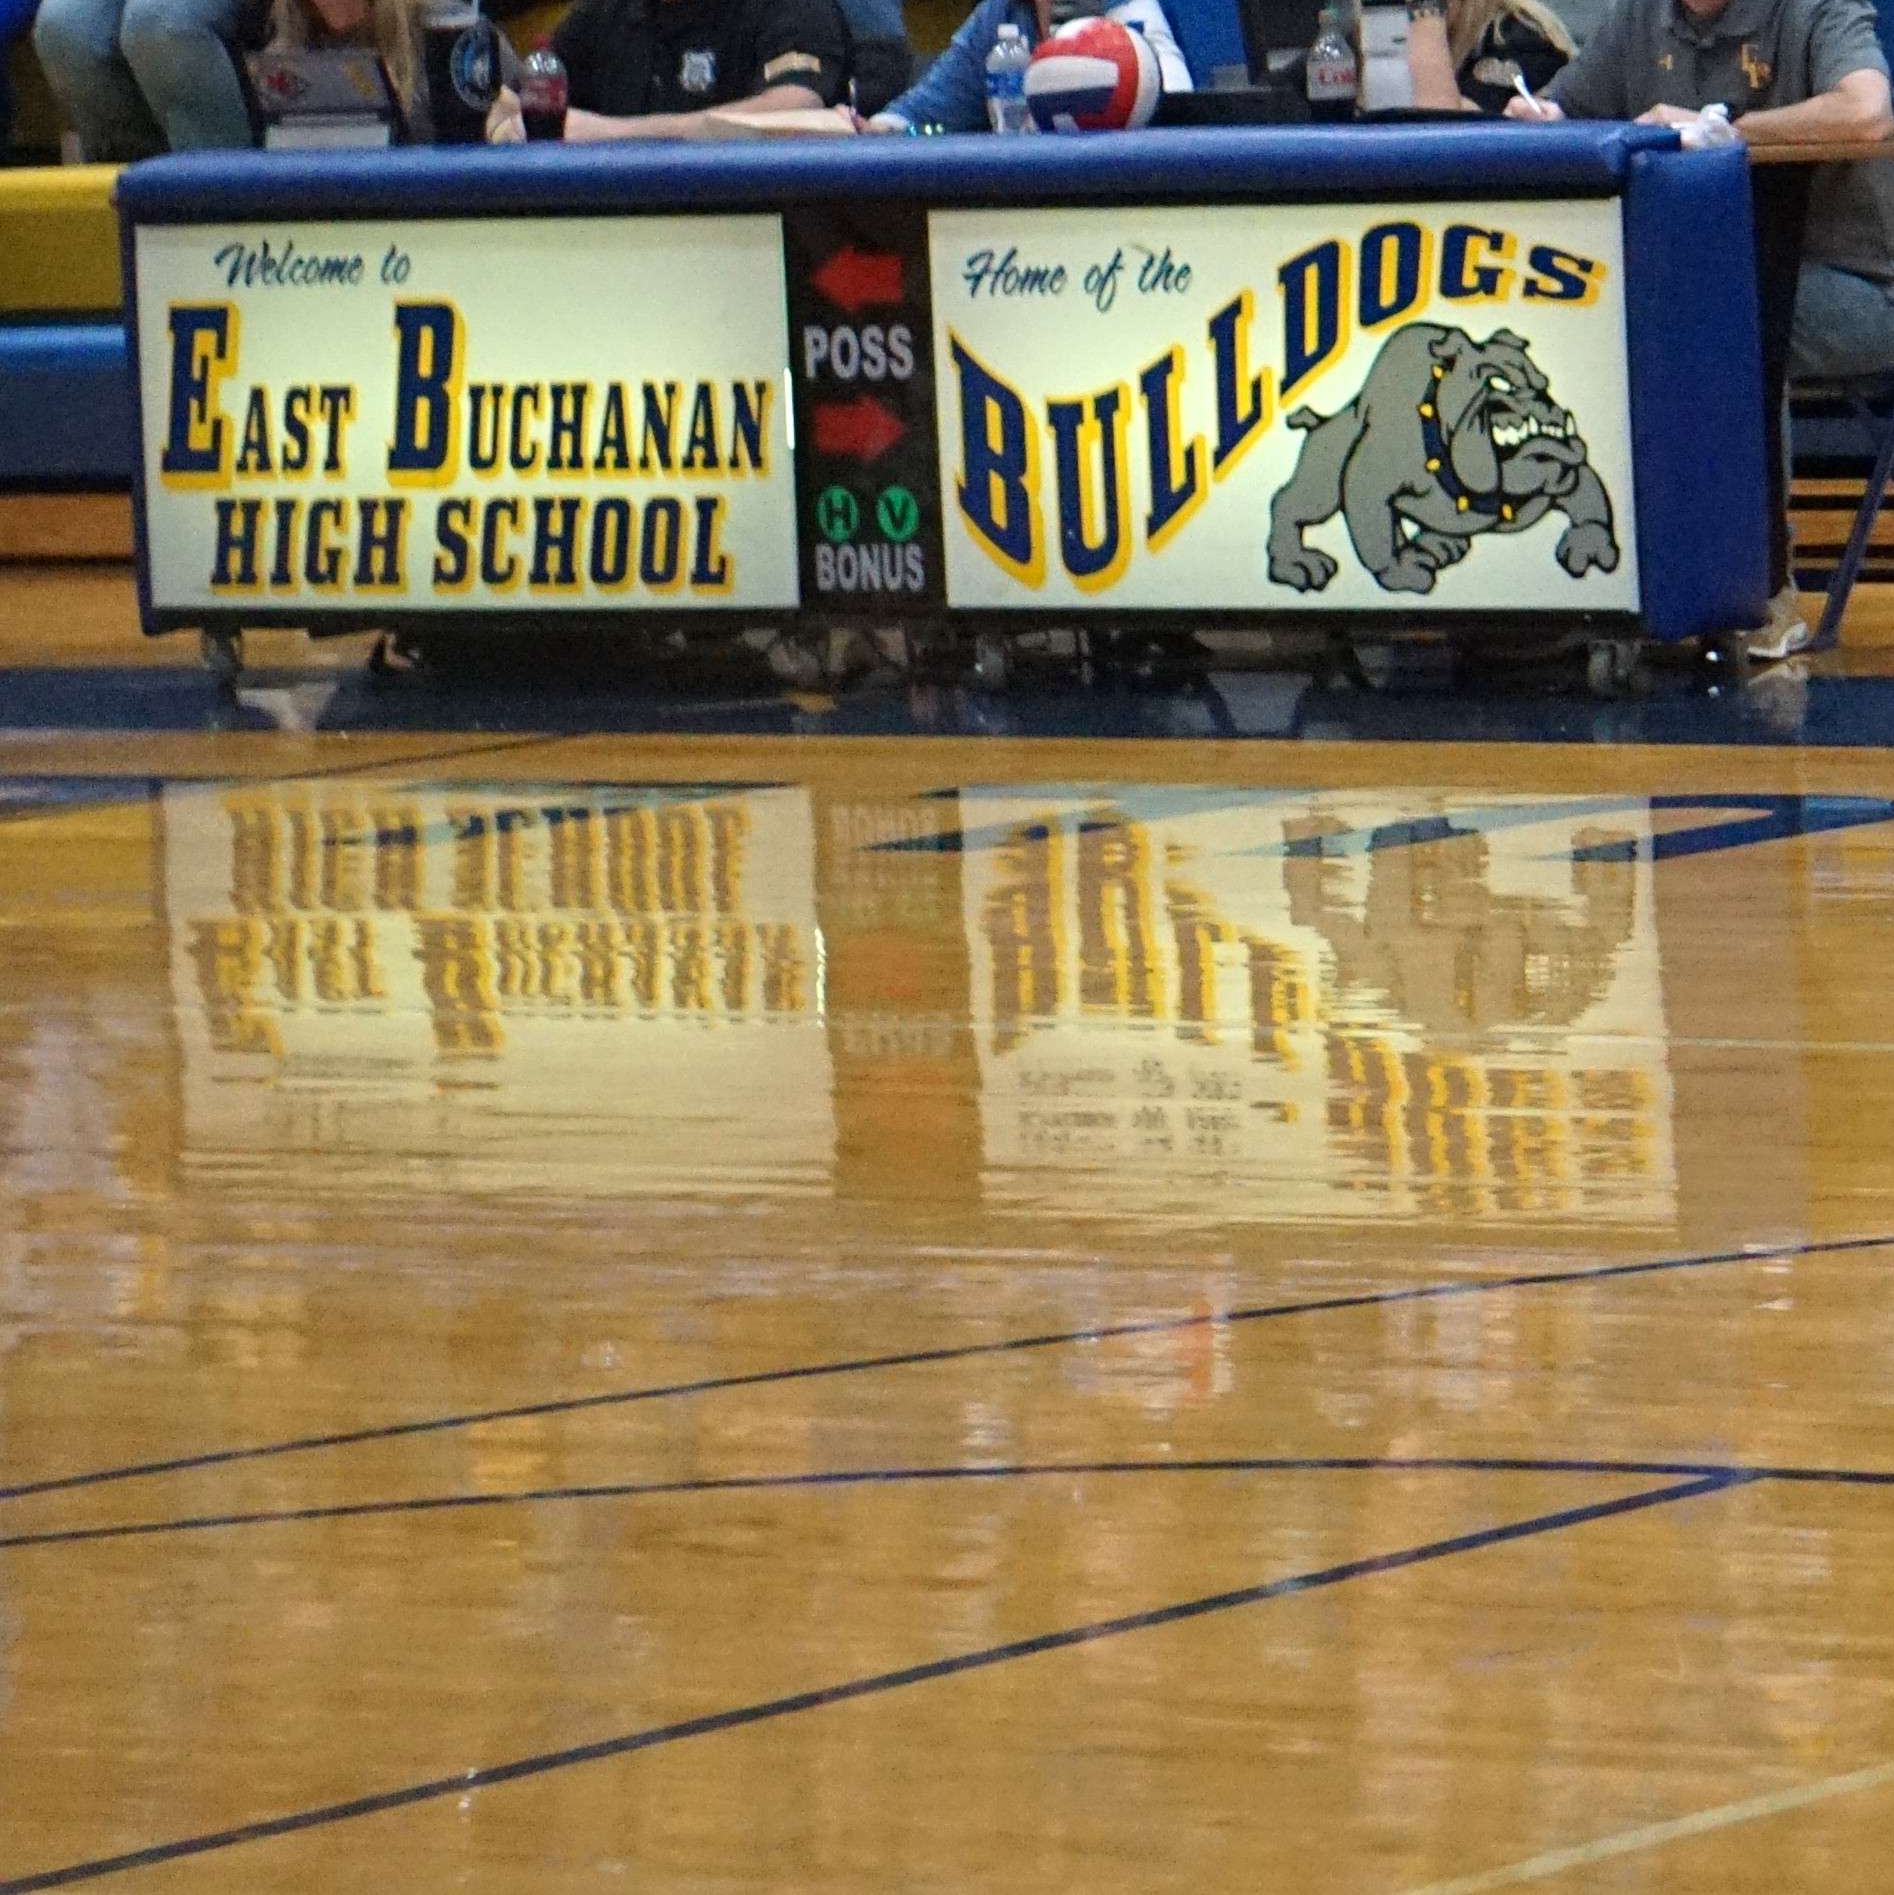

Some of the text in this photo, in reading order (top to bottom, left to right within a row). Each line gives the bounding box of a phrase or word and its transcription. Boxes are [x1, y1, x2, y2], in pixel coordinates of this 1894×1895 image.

[213, 240, 411, 288] Welcome to
[961, 248, 1193, 313] Home of the
[803, 323, 914, 382] POSS
[160, 298, 774, 490] EAST BUCHANAN
[950, 222, 1606, 594] BULLDOGS
[209, 493, 734, 597] HIGH SCHOOL
[814, 542, 925, 592] BONUS
